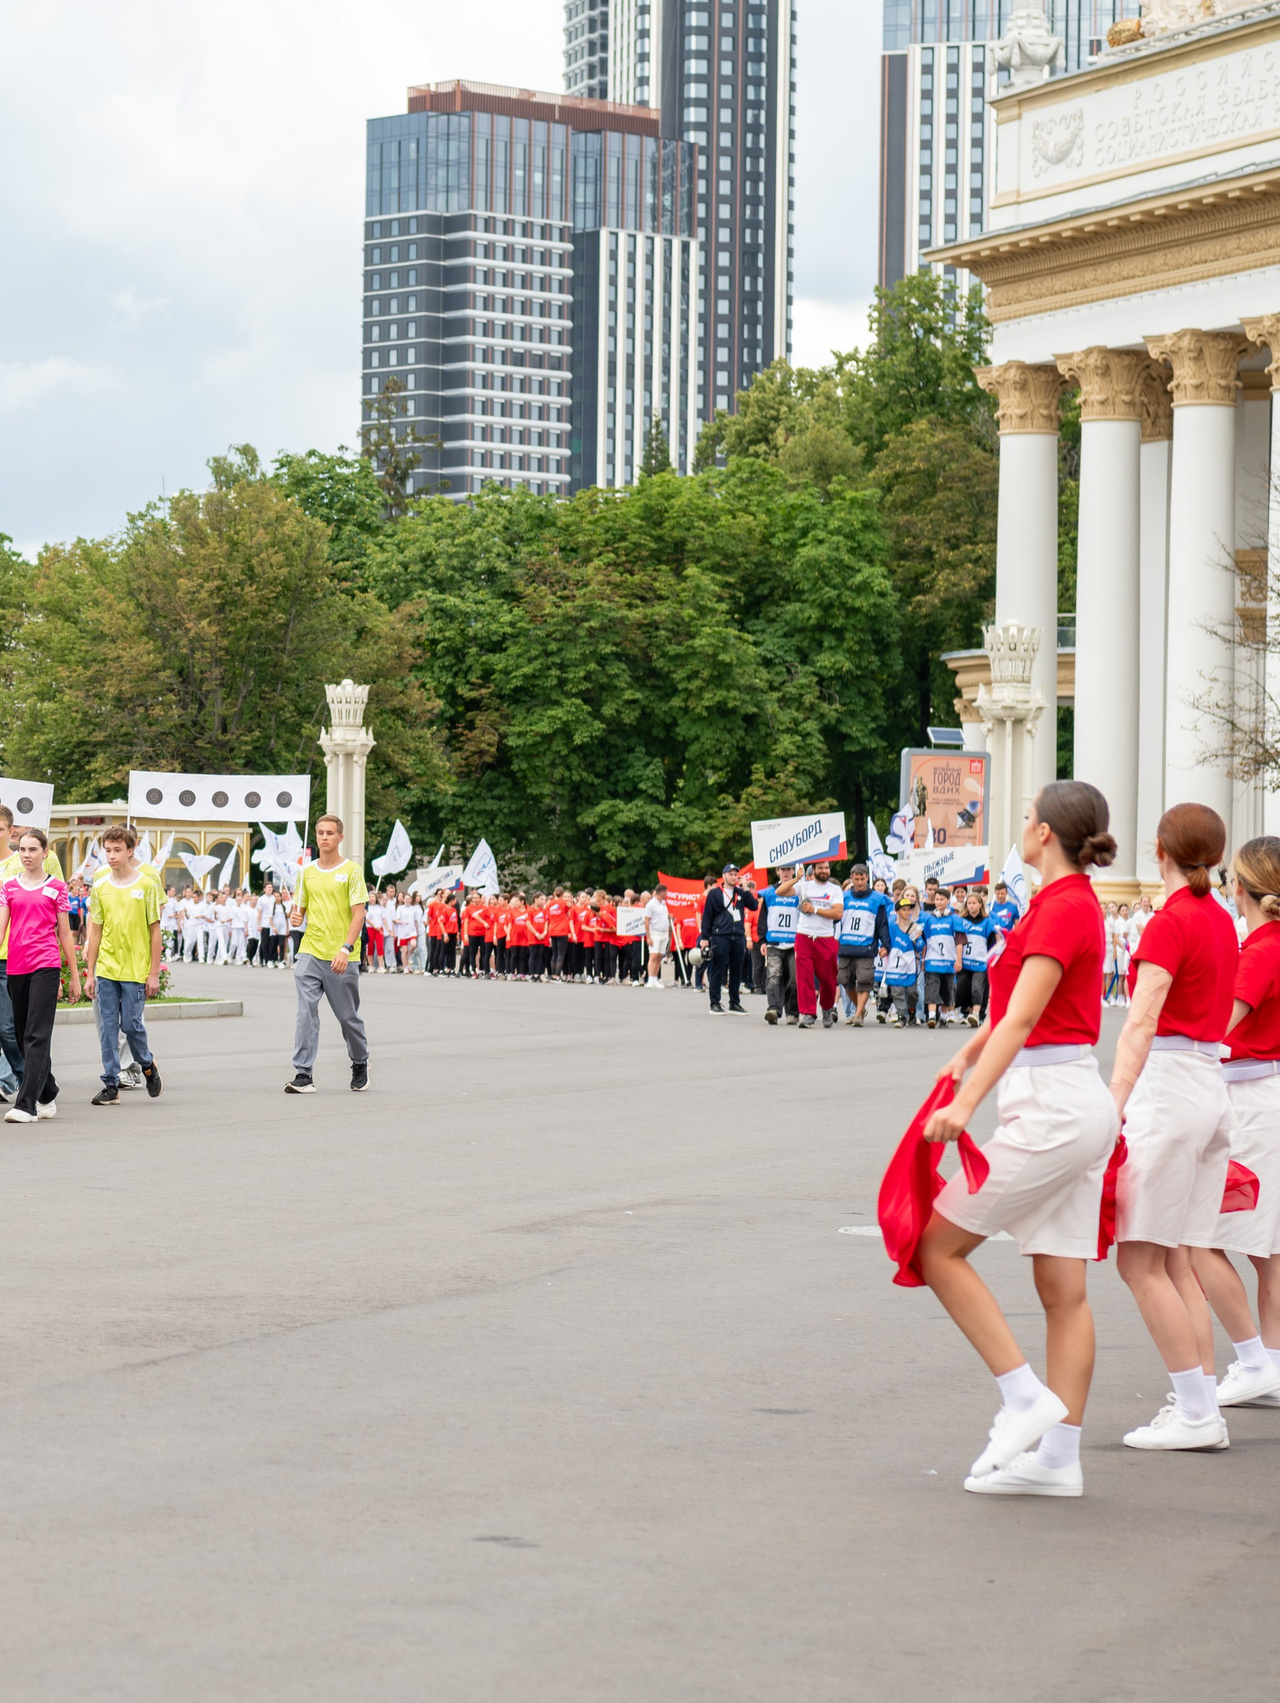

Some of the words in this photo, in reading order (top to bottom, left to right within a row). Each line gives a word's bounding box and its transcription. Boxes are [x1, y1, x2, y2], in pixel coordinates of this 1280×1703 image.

[1095, 95, 1205, 143] СОВЕТСКАЯ
[1095, 105, 1264, 167] СОЦИАЛИСТИЧЕСКАЯ
[933, 771, 961, 786] ГОРОД
[933, 786, 960, 794] ВДНХ
[769, 819, 822, 863] СНОУБОРД
[923, 850, 955, 875] ЛЫЖНЫЕ
[778, 914, 791, 928] 20
[850, 917, 861, 931] 18
[938, 942, 945, 956] 2
